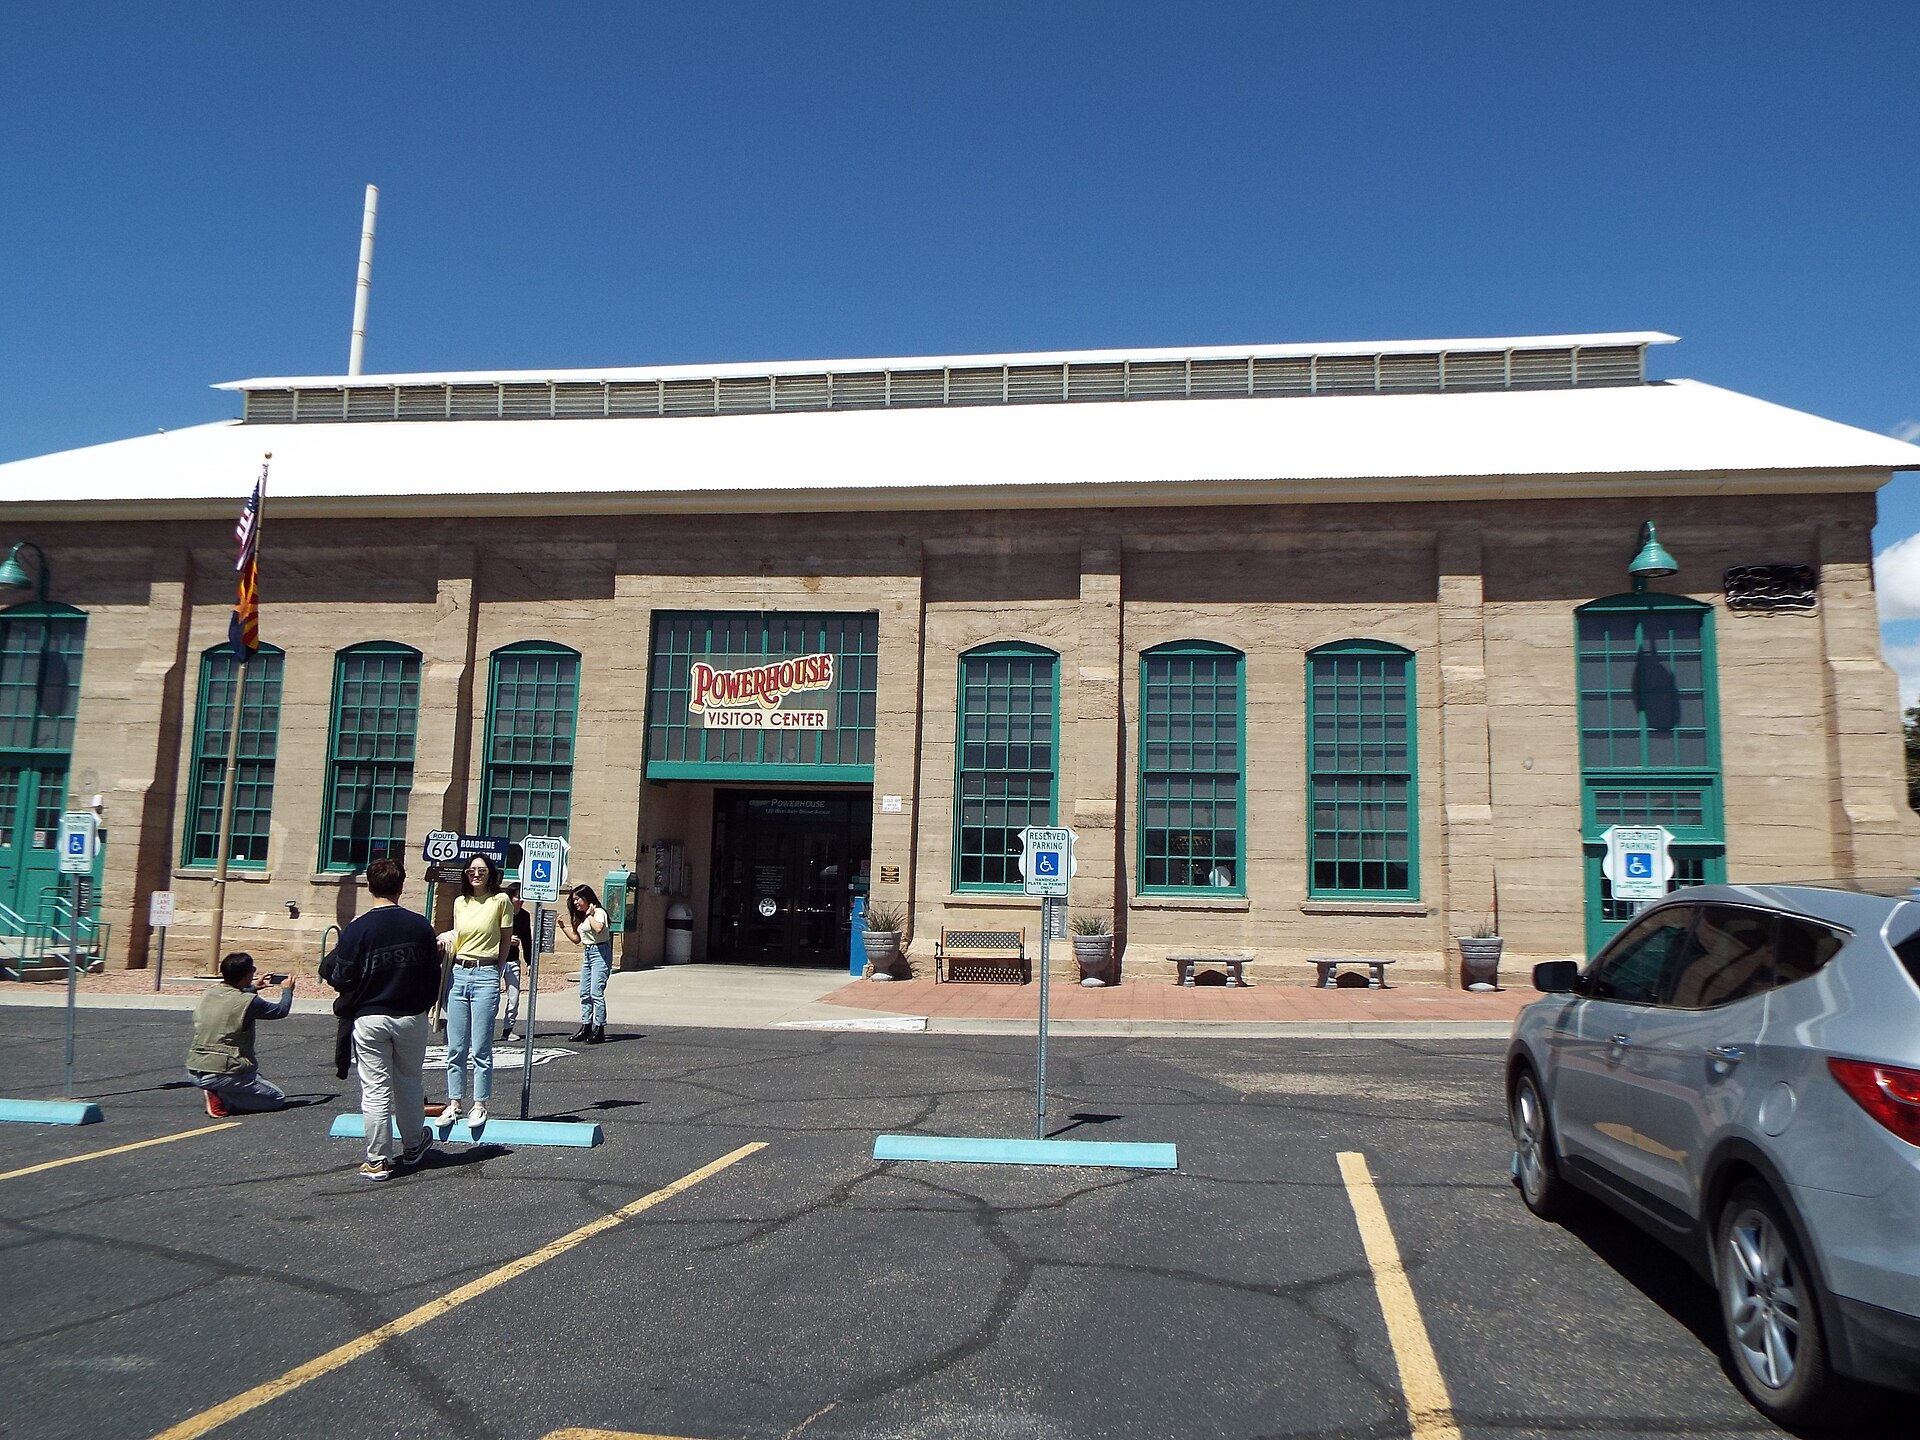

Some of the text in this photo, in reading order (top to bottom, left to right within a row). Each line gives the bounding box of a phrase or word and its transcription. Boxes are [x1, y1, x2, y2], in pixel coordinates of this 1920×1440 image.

[690, 654, 832, 711] POWERHOUSE
[707, 711, 824, 727] VISITOR CENTER
[770, 798, 826, 808] POWERHOUSE
[1029, 831, 1066, 841] RESERVED
[1616, 832, 1659, 841] RESERVED
[460, 839, 496, 849] ROADSIDE
[528, 841, 559, 850] RESERVED
[1032, 841, 1063, 850] PARKING
[432, 841, 453, 858] 66
[529, 850, 556, 859] PARKING
[459, 850, 503, 861] ATTTION
